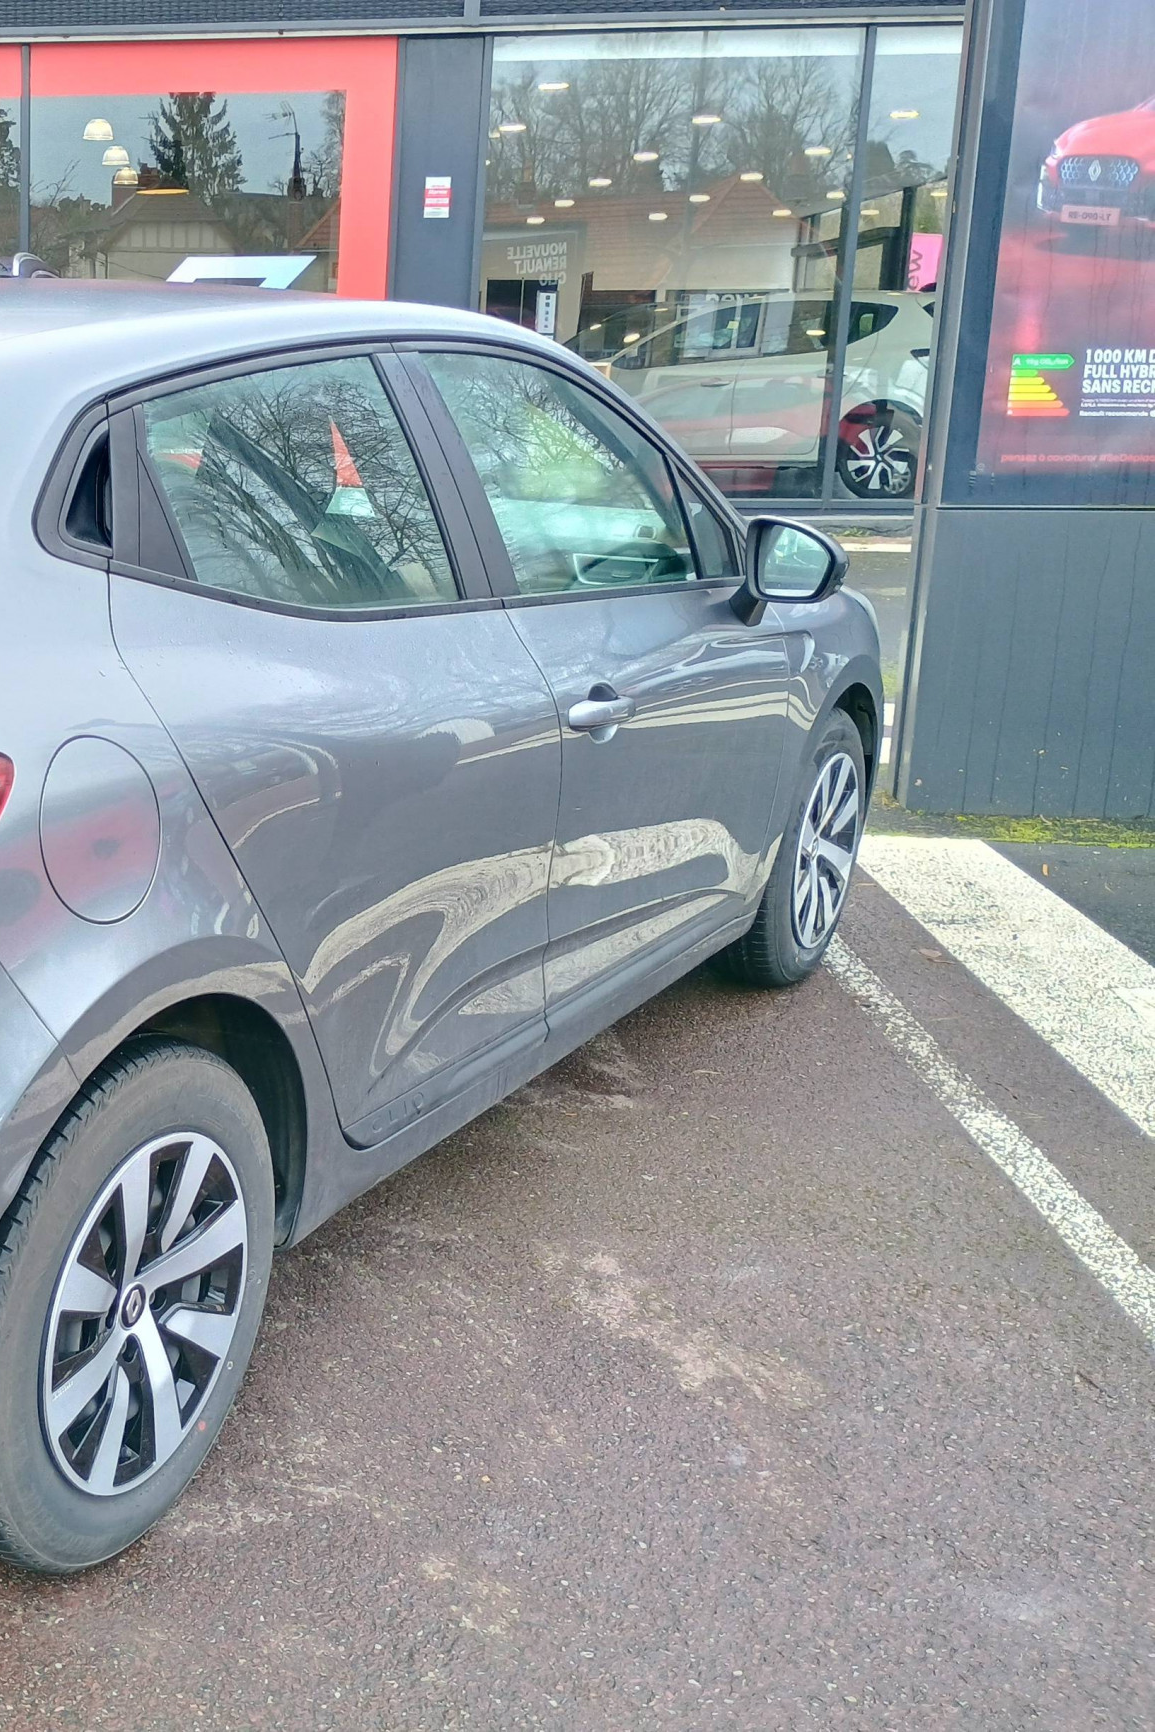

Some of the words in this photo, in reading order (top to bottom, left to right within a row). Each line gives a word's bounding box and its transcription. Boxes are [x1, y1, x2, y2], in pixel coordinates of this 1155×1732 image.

[1124, 349, 1147, 364] KM
[1083, 364, 1118, 379] FULL
[1120, 364, 1155, 379] HYBR
[1082, 379, 1121, 394] SANS
[372, 1091, 425, 1134] CLIO
